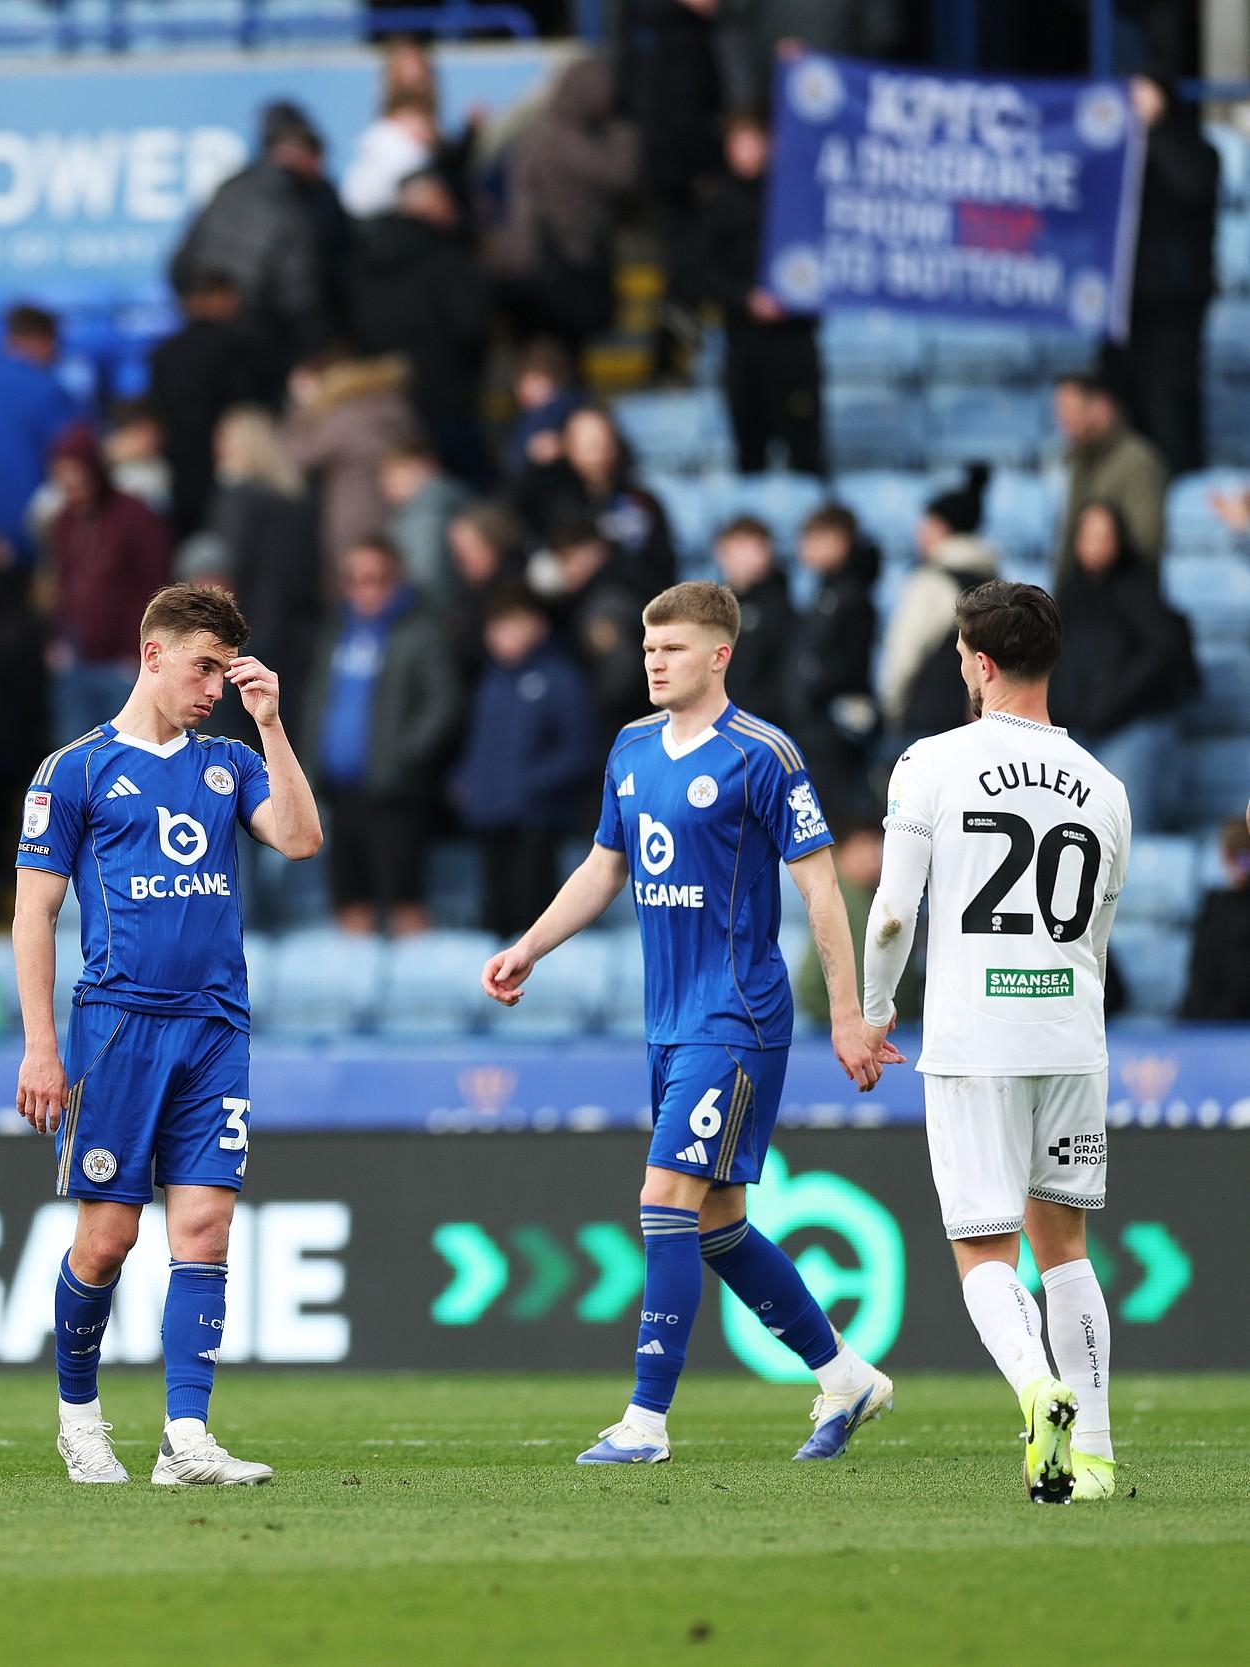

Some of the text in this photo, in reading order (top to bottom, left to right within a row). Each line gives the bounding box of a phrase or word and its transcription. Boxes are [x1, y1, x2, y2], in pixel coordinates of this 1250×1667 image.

[856, 137, 1080, 208] DISGRACE
[825, 190, 950, 241] FROM
[886, 251, 1063, 303] BOTTOM
[979, 762, 1091, 808] CULLEN
[130, 873, 230, 900] BC.GAME
[961, 811, 1102, 943] 20
[990, 973, 1070, 986] SWANSEA
[990, 986, 1070, 994] BUILDING SOCIETY
[689, 1088, 722, 1139] 6
[1074, 1133, 1104, 1144] FIRST
